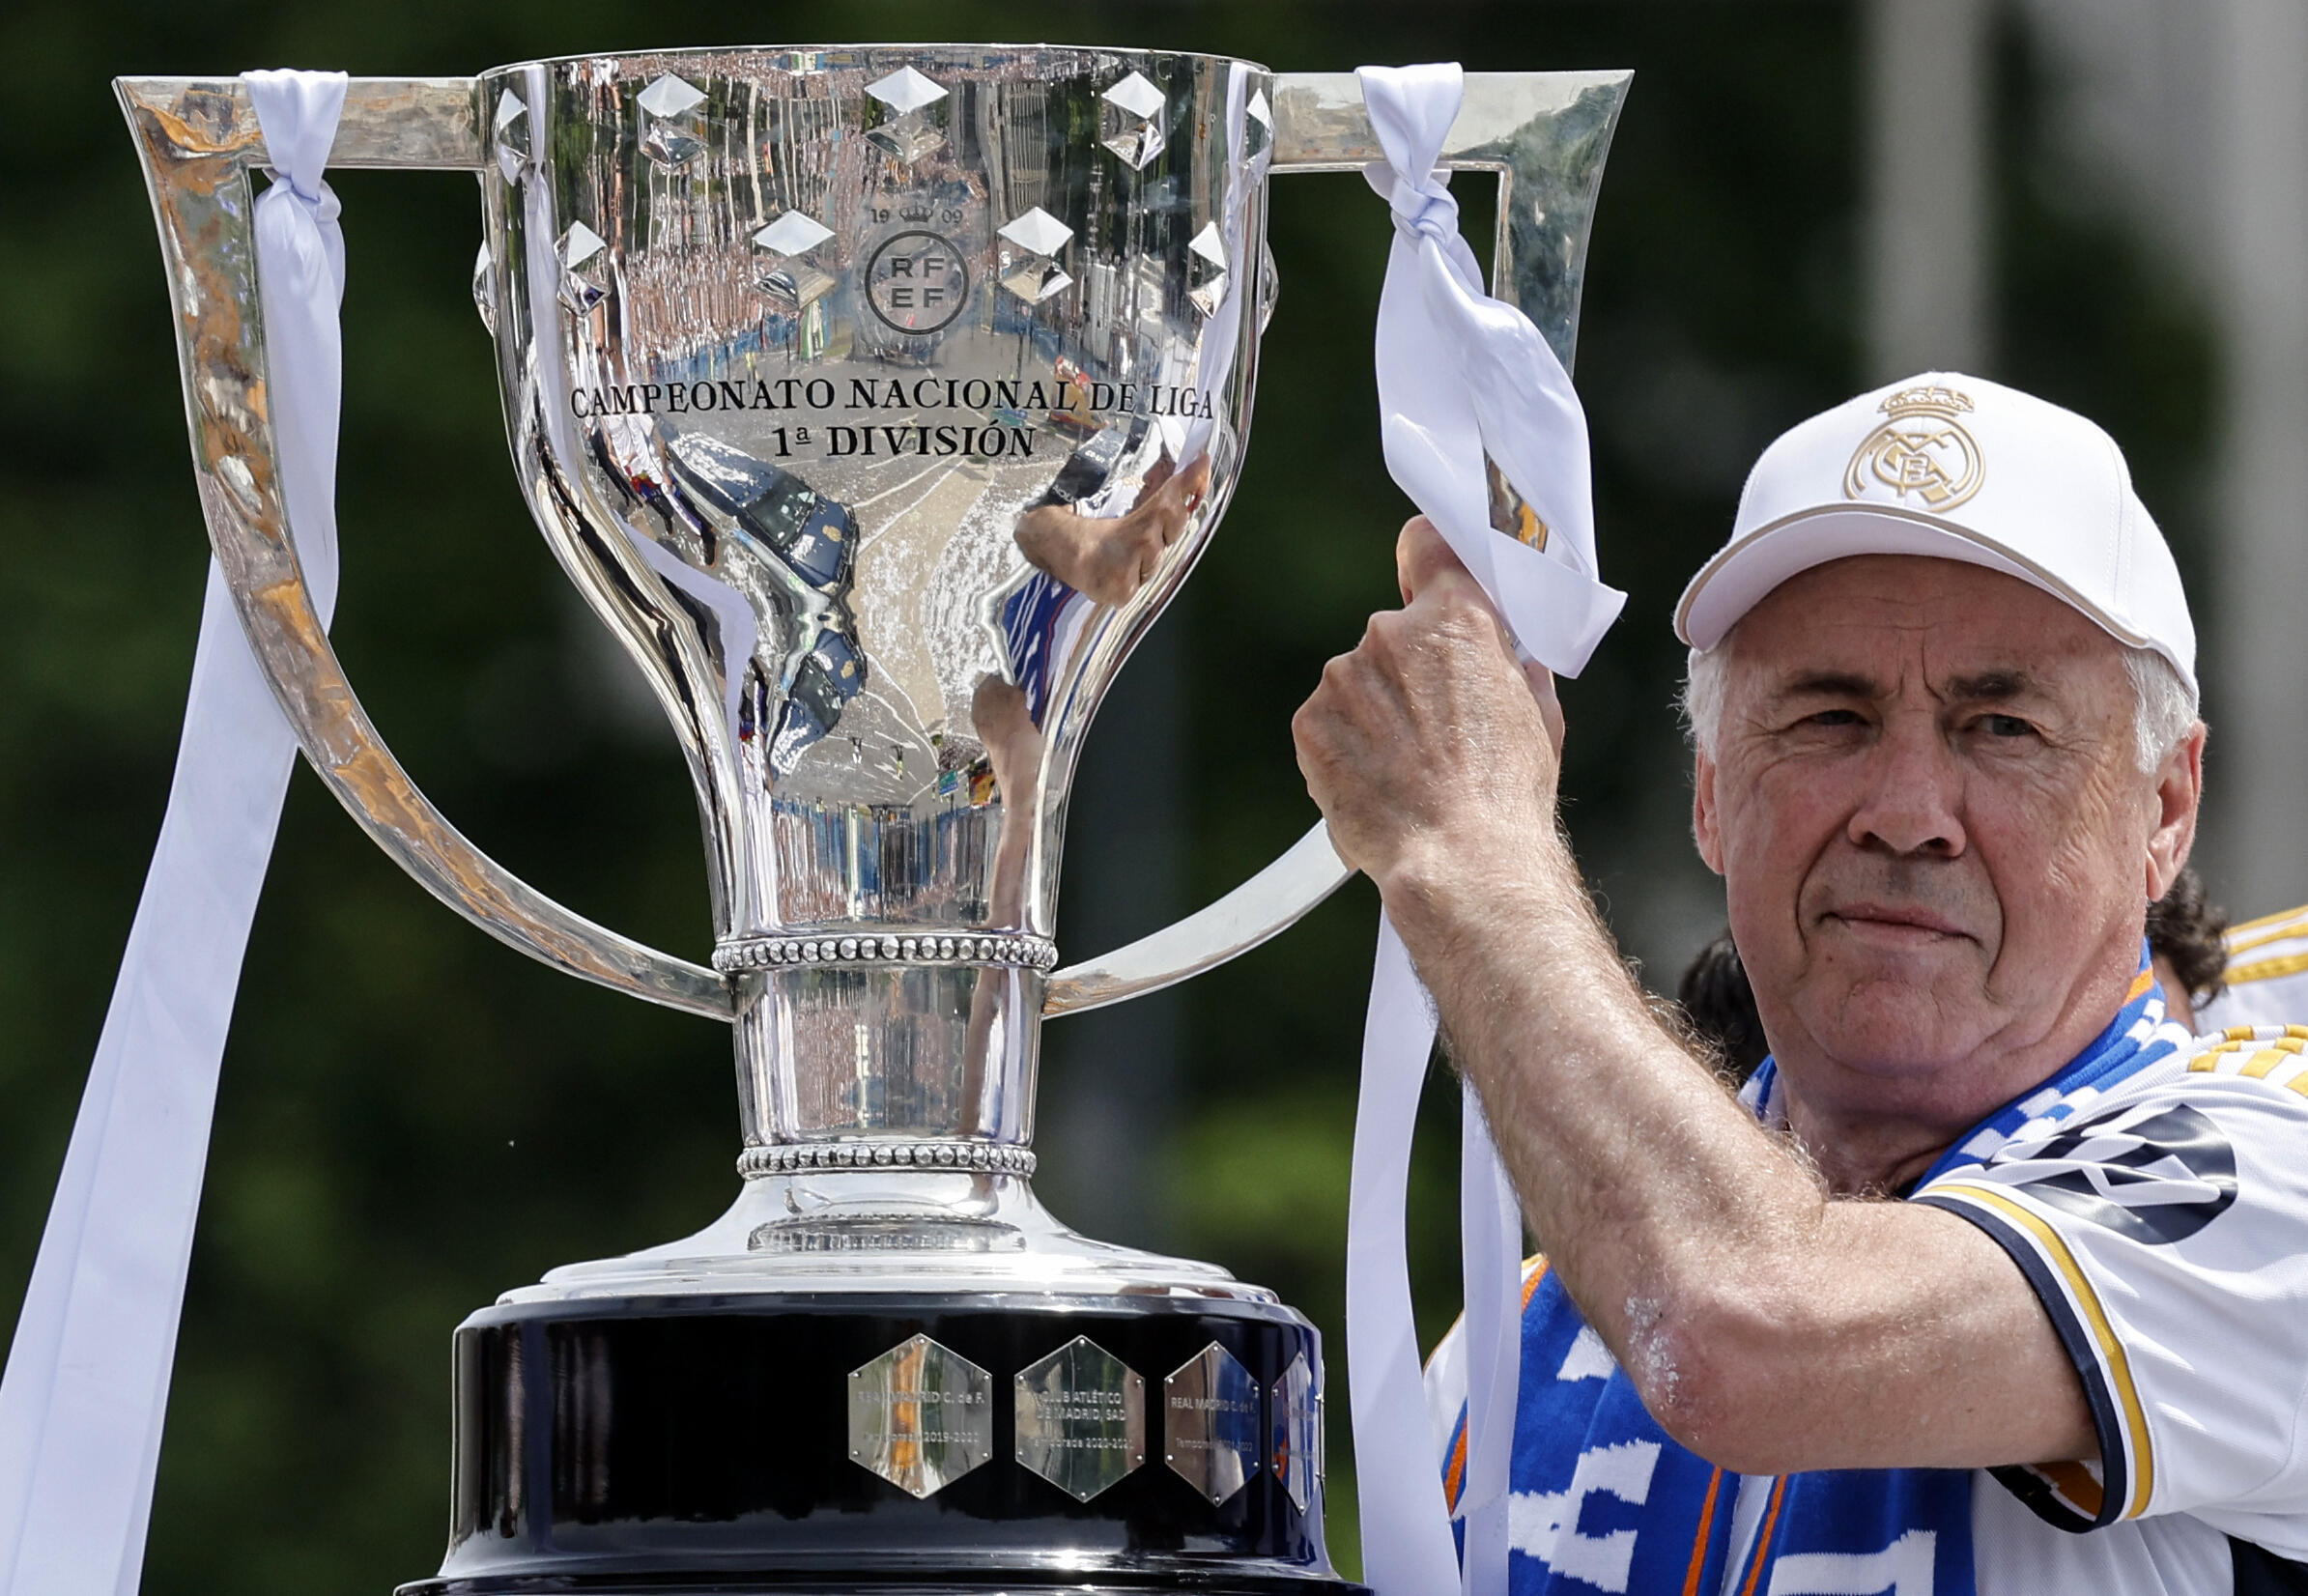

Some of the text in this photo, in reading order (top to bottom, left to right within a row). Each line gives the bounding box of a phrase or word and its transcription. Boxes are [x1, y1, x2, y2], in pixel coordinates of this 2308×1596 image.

[870, 208, 964, 224] 19 09
[570, 378, 1213, 420] CAMPEONATO NACIONAL DE LIGA
[826, 418, 1041, 458] DIVISIÓN
[1072, 1389, 1122, 1405] ATLÉTICO
[1170, 1397, 1194, 1410] REAL
[1106, 1409, 1126, 1421] SAD
